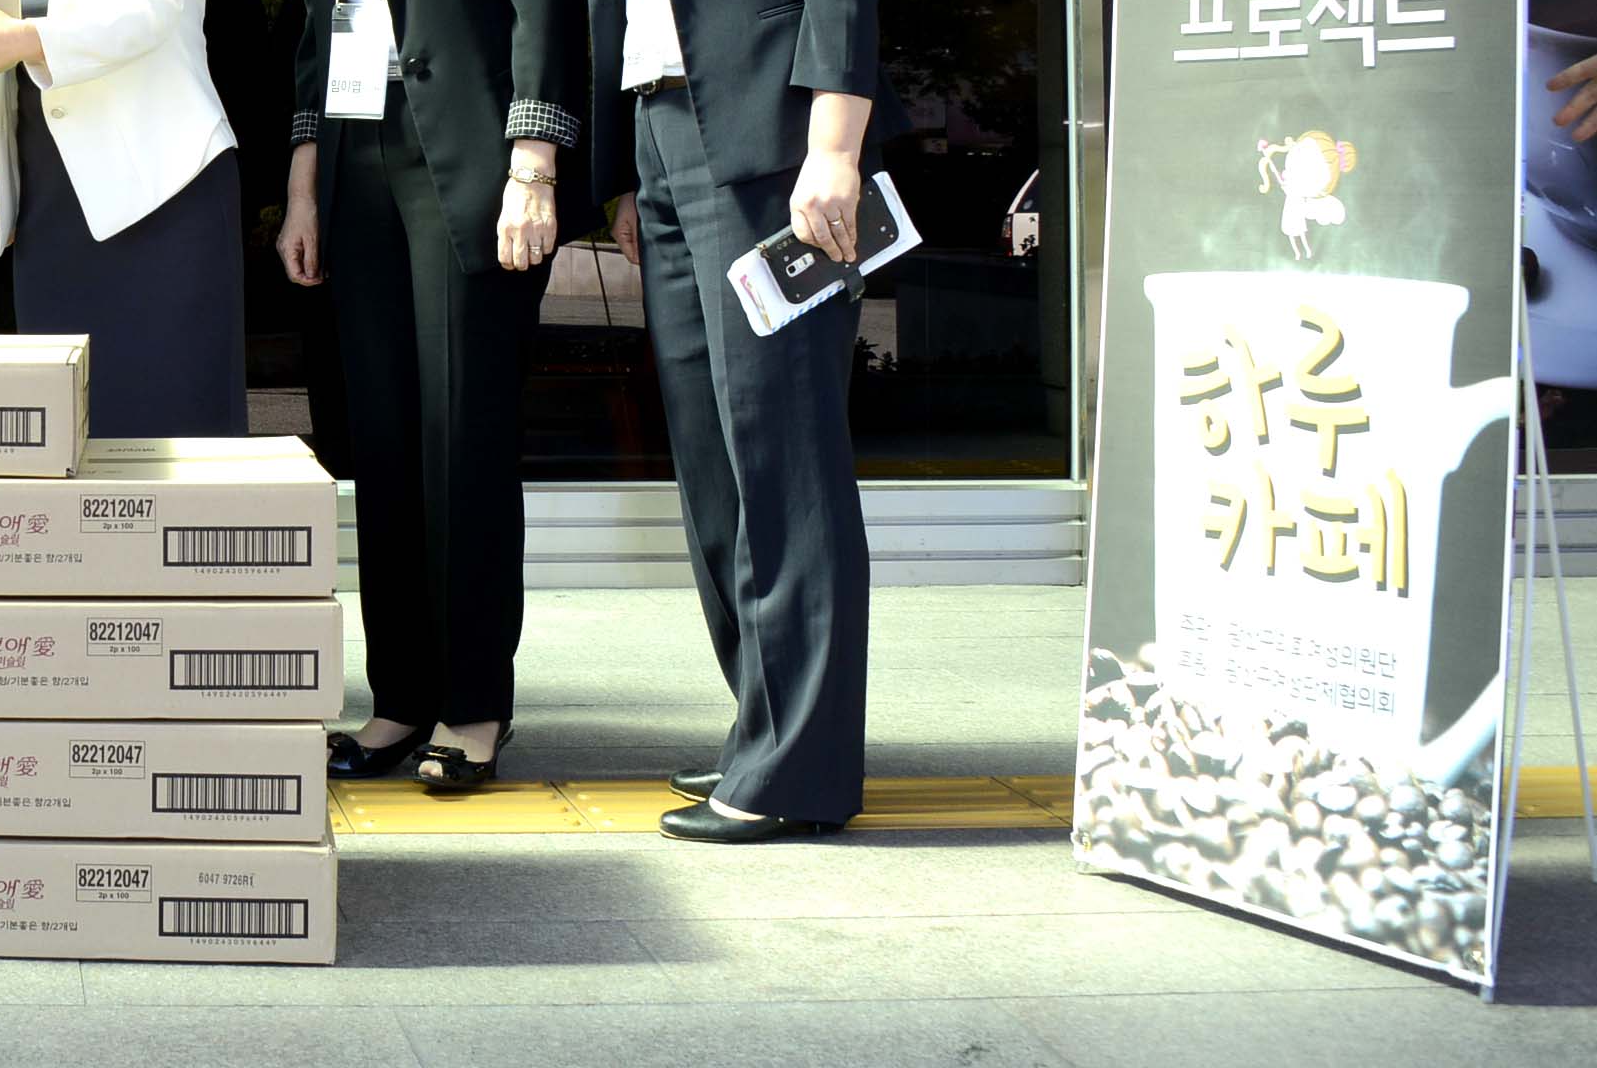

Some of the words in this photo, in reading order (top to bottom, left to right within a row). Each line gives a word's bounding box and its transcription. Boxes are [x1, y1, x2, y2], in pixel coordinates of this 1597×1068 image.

[1179, 304, 1371, 479] 하루
[83, 498, 153, 519] 82212047
[1204, 459, 1409, 599] 카페
[89, 621, 159, 642] 82212047
[72, 744, 142, 765] 82212047
[78, 868, 148, 889] 82212047
